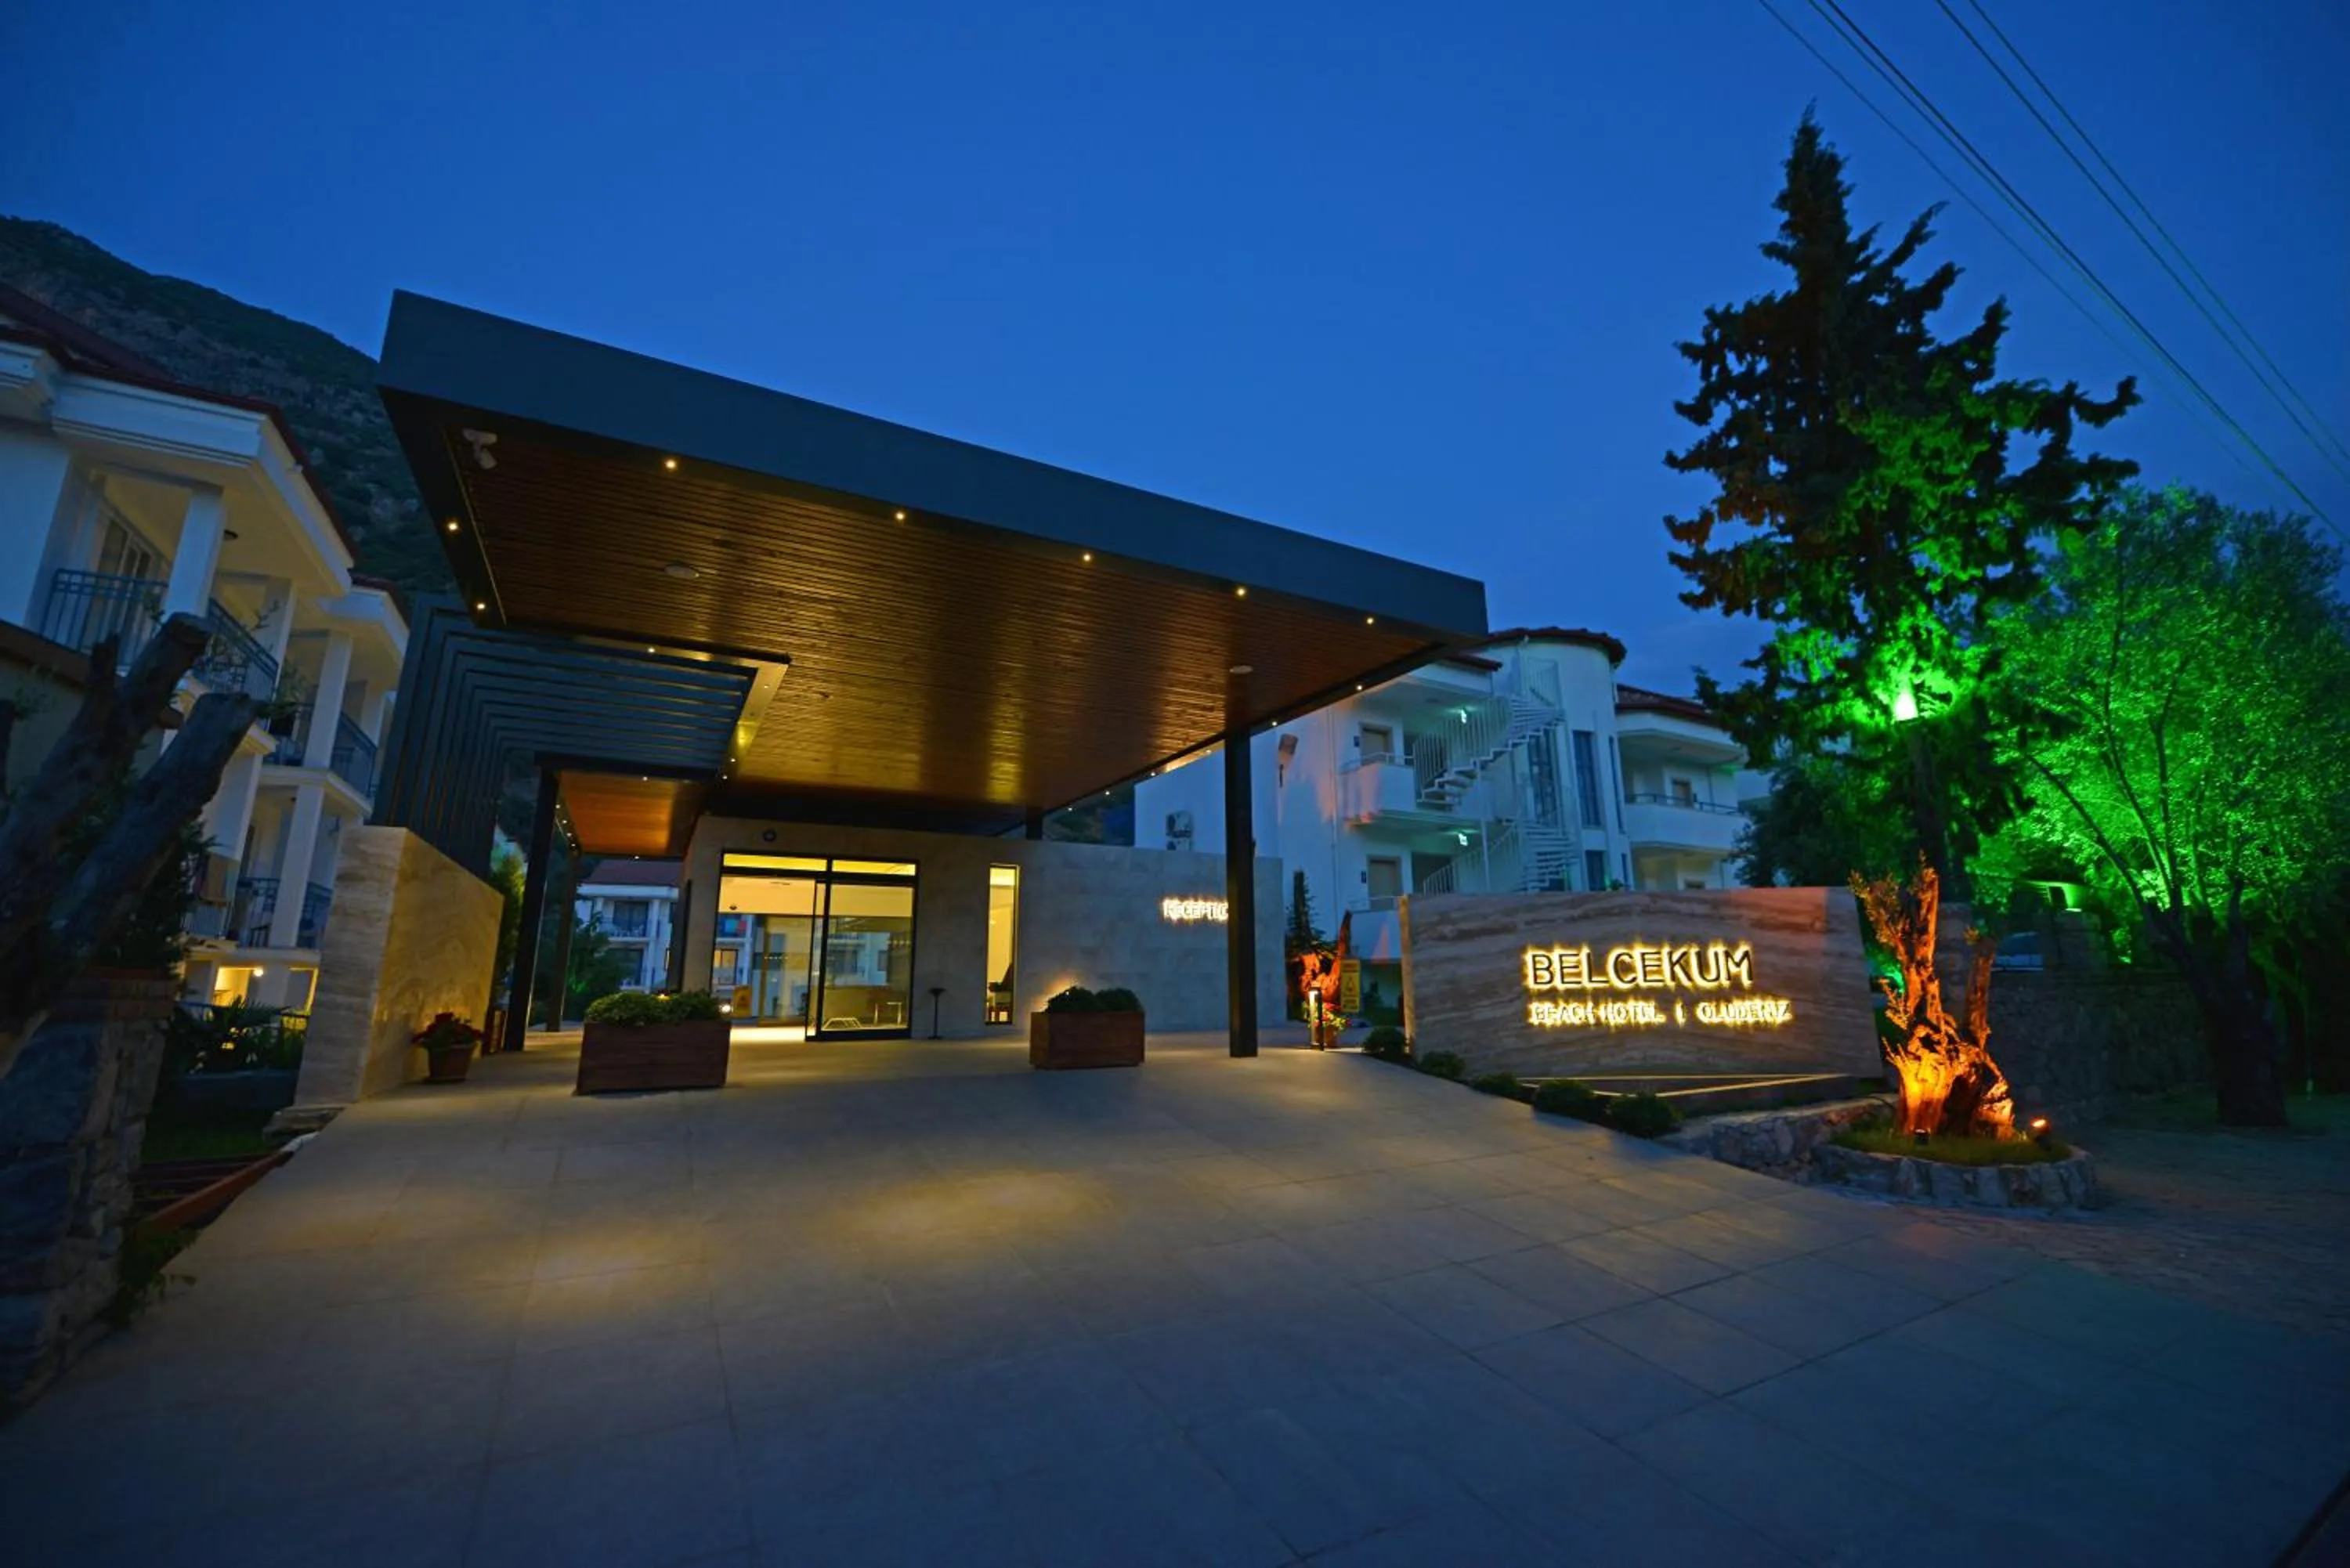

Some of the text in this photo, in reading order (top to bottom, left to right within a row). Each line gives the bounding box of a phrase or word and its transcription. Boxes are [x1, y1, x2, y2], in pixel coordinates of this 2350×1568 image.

[1163, 898, 1228, 919] RECEPTIO
[1528, 946, 1755, 987] BELCEKUM
[1531, 1000, 1596, 1024] BEACH
[1600, 1000, 1665, 1024] HOTEL
